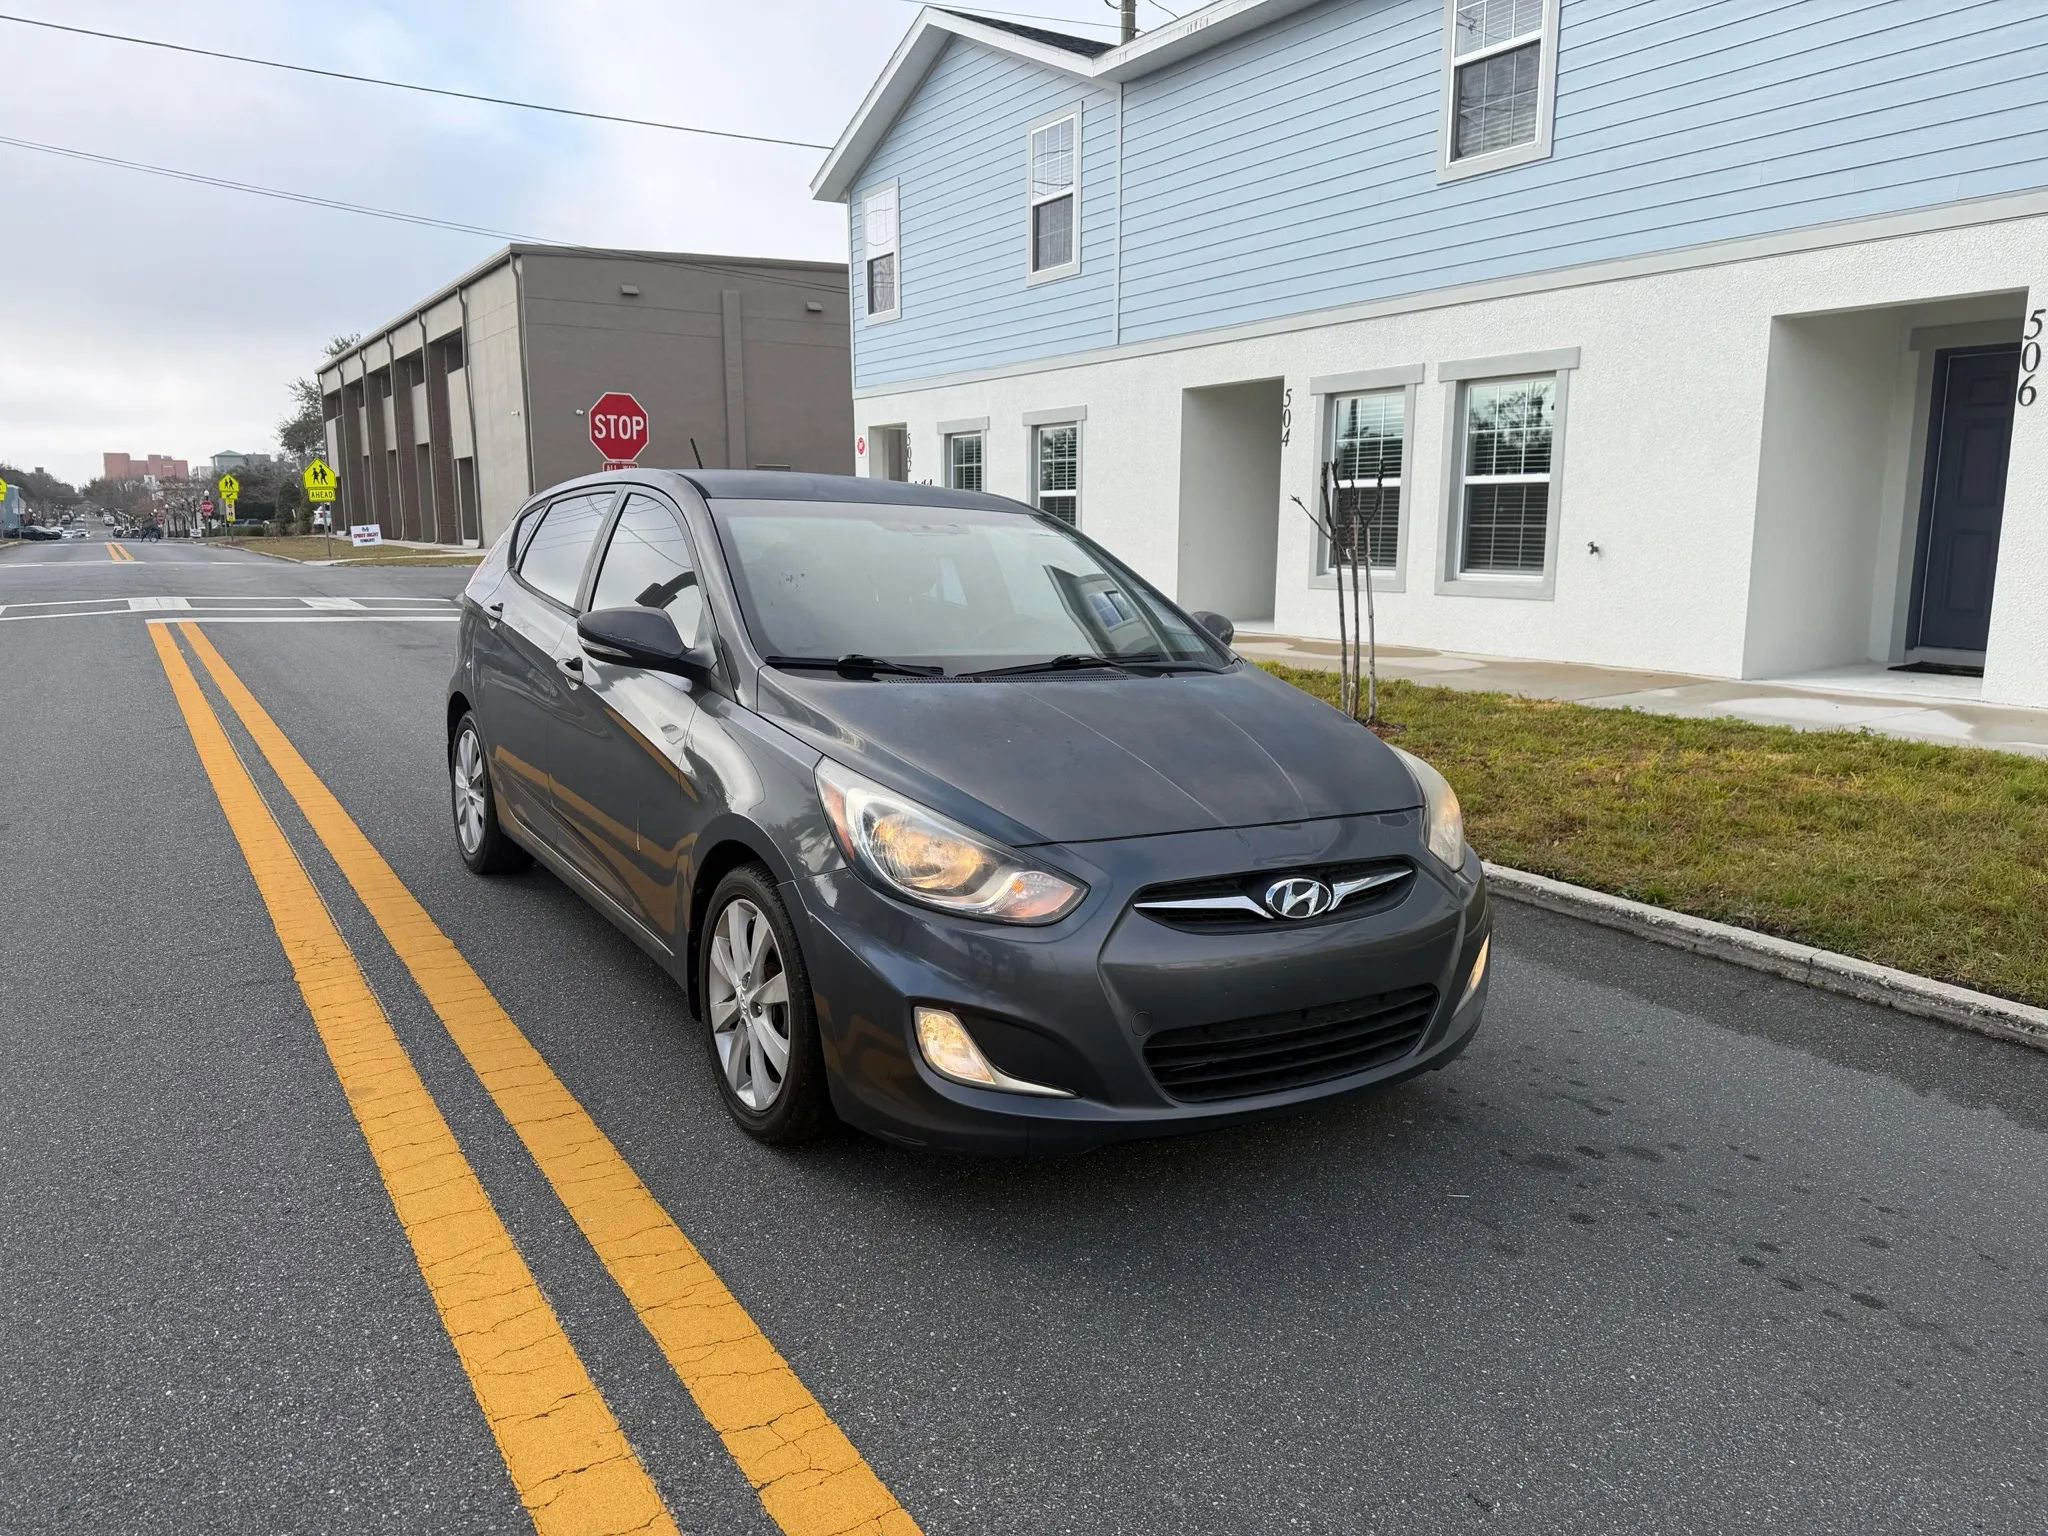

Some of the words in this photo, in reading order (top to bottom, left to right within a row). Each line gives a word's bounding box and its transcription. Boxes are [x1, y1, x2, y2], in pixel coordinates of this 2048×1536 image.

[2017, 308, 2047, 407] 506
[594, 414, 644, 440] STOP
[1281, 388, 1292, 447] 504
[311, 490, 333, 499] AHEAD
